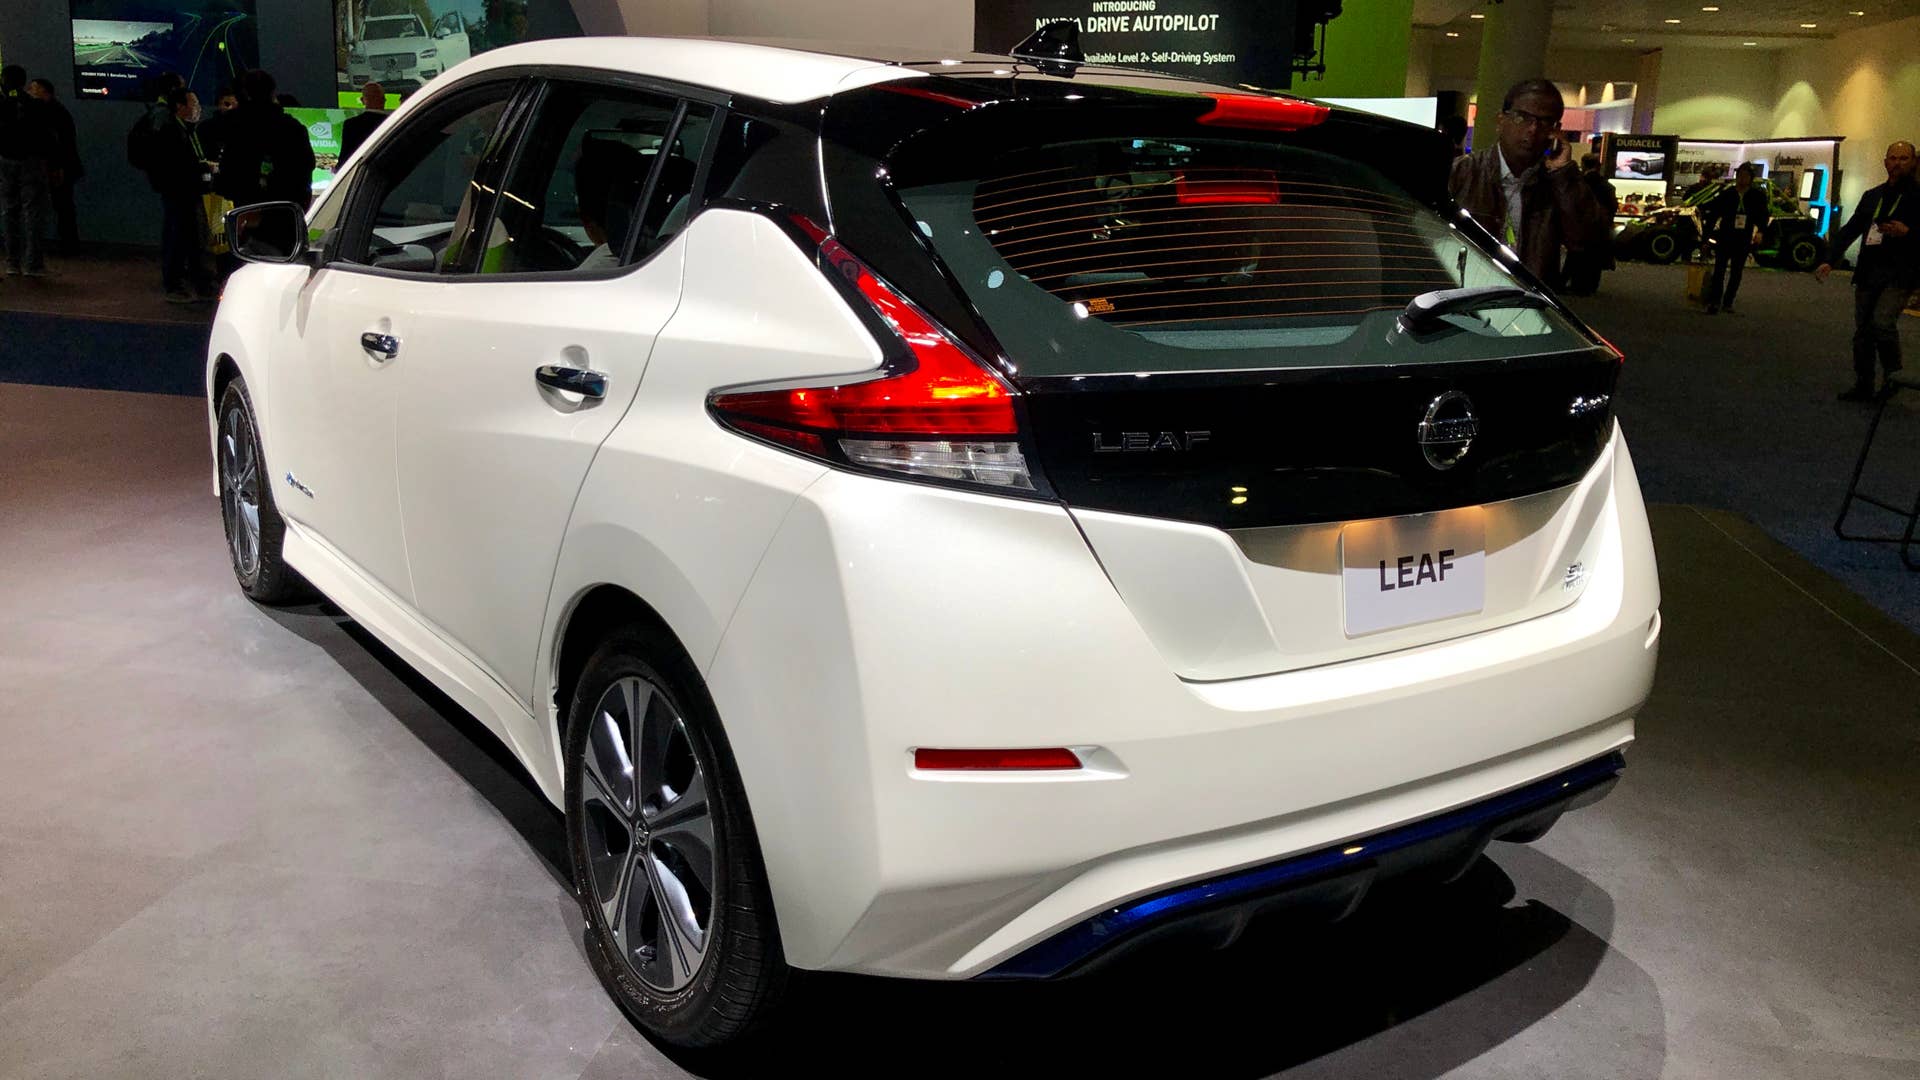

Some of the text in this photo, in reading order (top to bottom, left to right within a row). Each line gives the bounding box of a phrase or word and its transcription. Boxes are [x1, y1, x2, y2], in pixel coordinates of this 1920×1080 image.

[1093, 0, 1156, 12] INTRODUCING
[1087, 16, 1130, 32] DRIVE
[1133, 14, 1219, 32] AUTOPILOT
[1118, 52, 1138, 63] Level
[1151, 51, 1201, 65] Self-Driving
[1203, 51, 1236, 64] System
[1616, 138, 1662, 149] DURACELL
[1092, 430, 1211, 453] LEAF
[1379, 548, 1455, 592] LEAF
